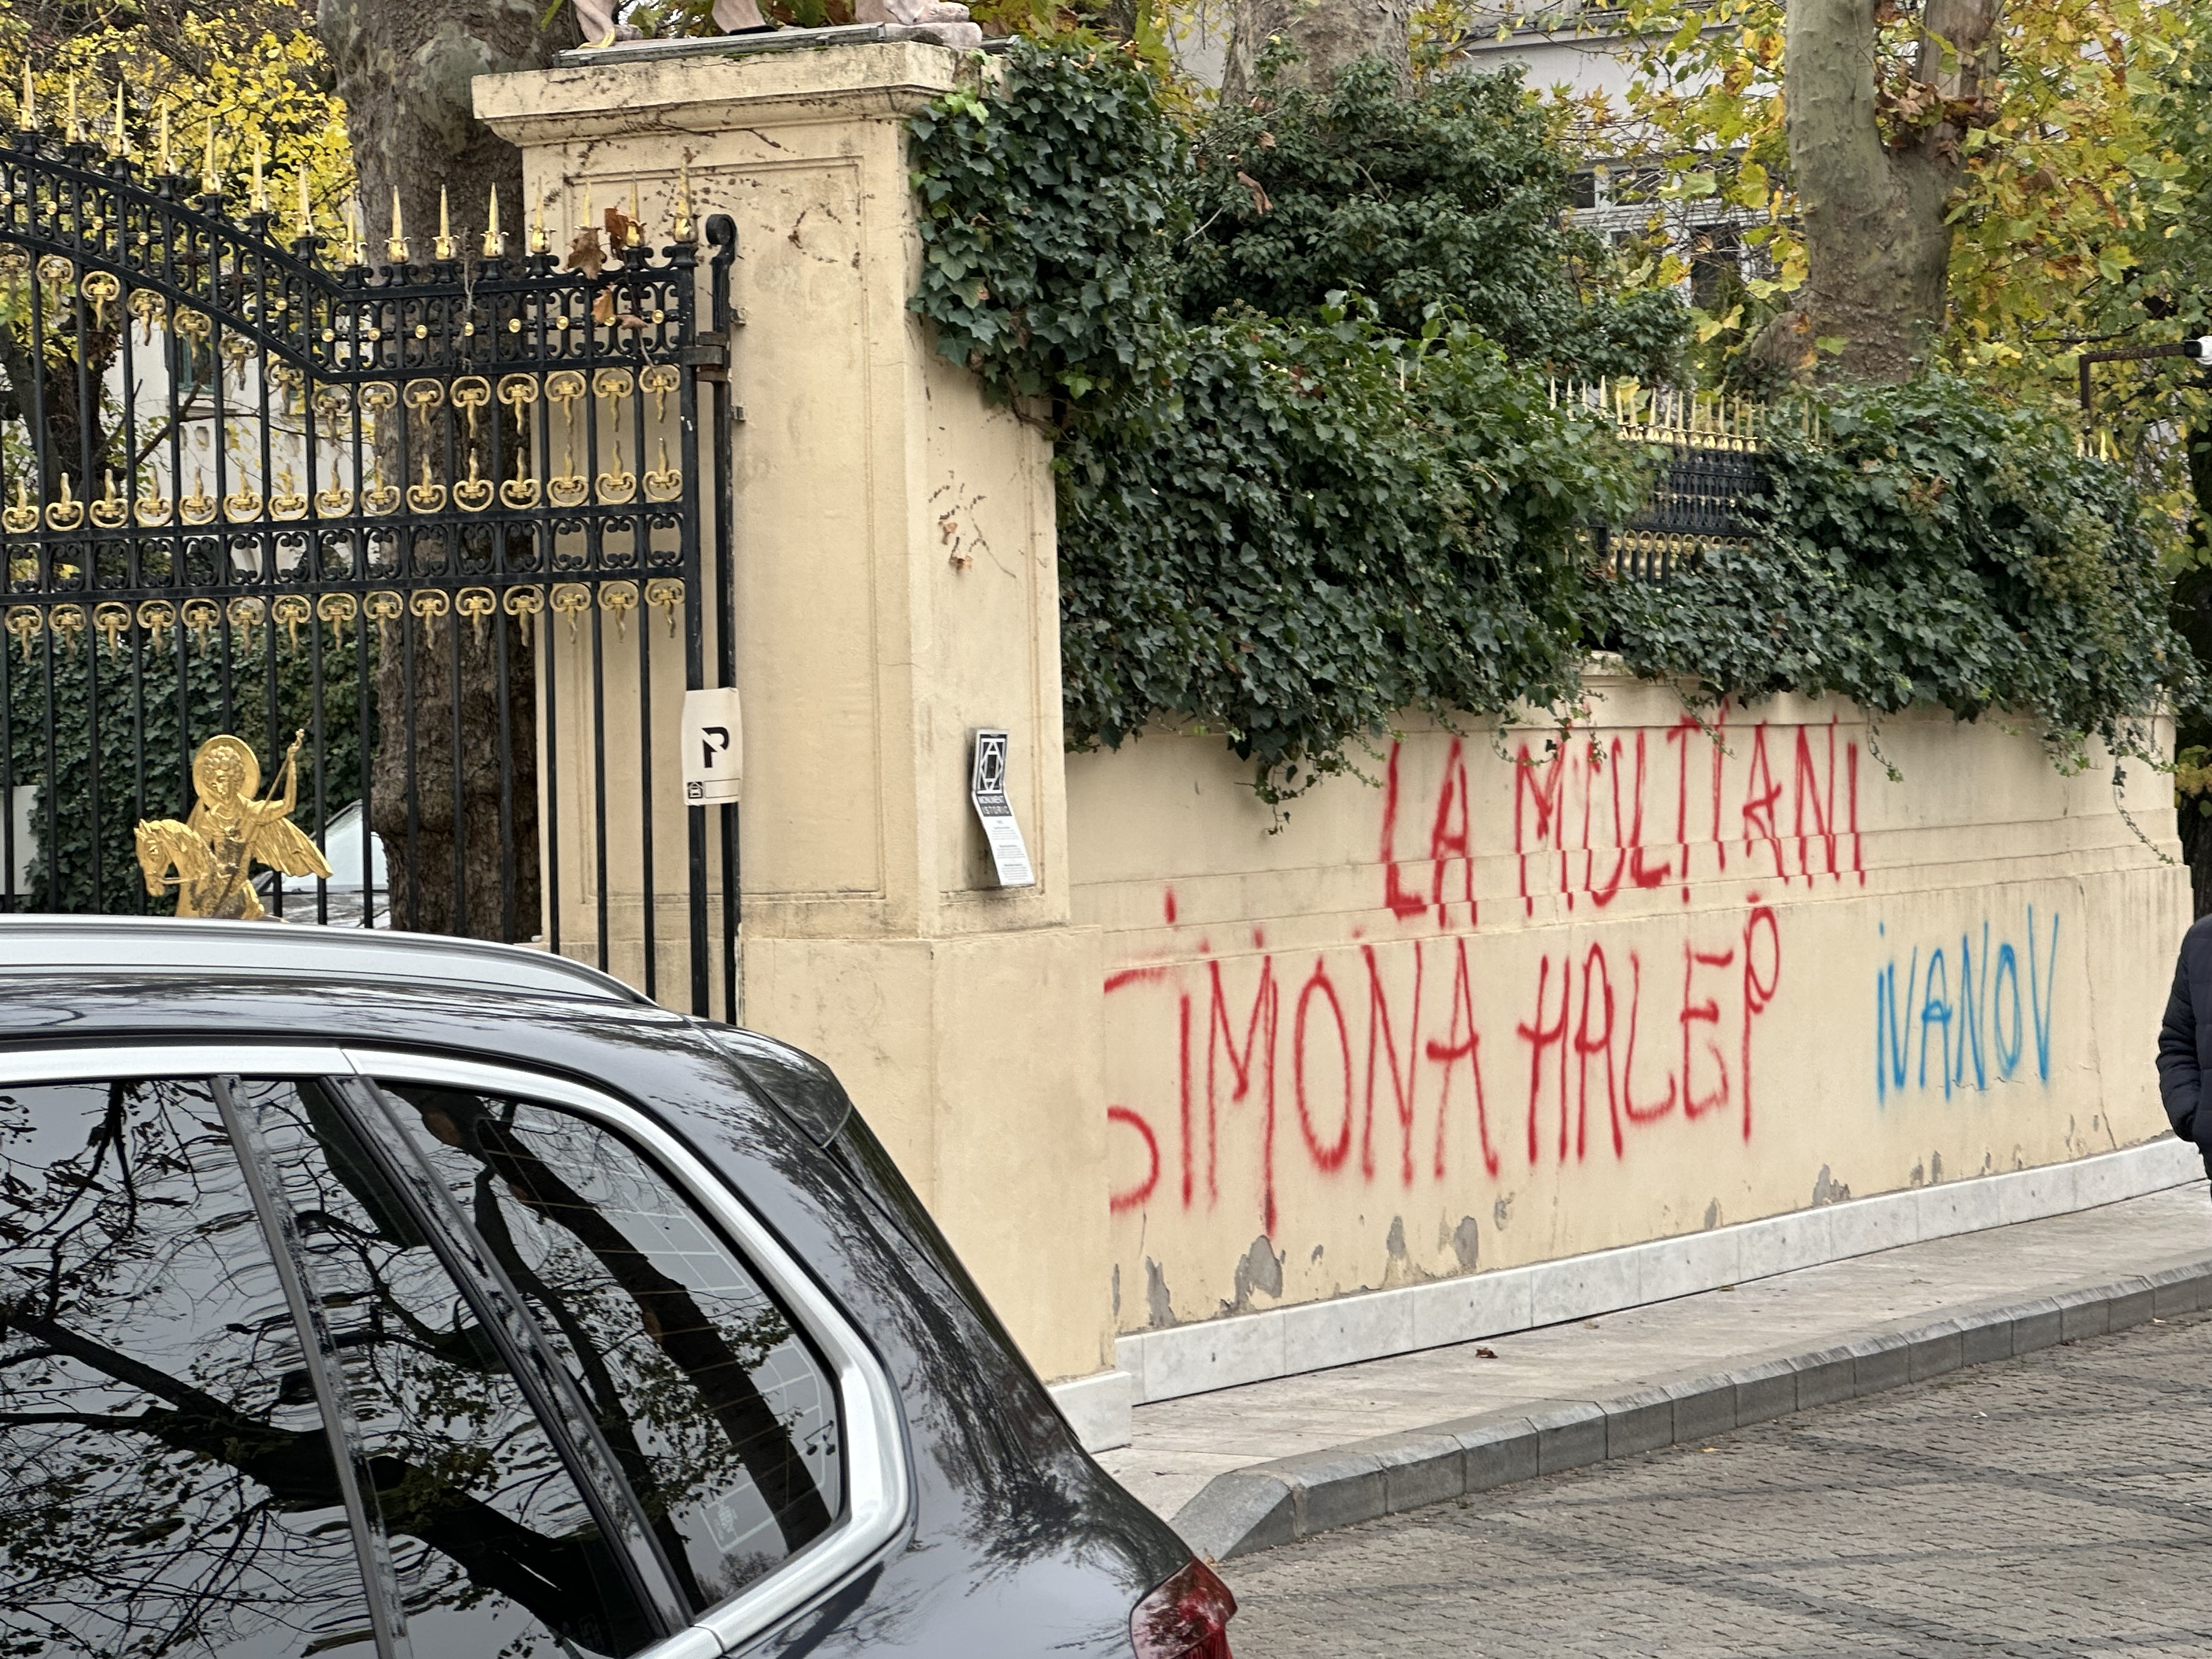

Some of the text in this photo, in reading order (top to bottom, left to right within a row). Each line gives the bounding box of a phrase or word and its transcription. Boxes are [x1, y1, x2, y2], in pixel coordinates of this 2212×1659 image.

[1380, 735, 1478, 929] LA
[1742, 712, 1866, 889] ANI
[1516, 889, 1780, 1167] HALEP
